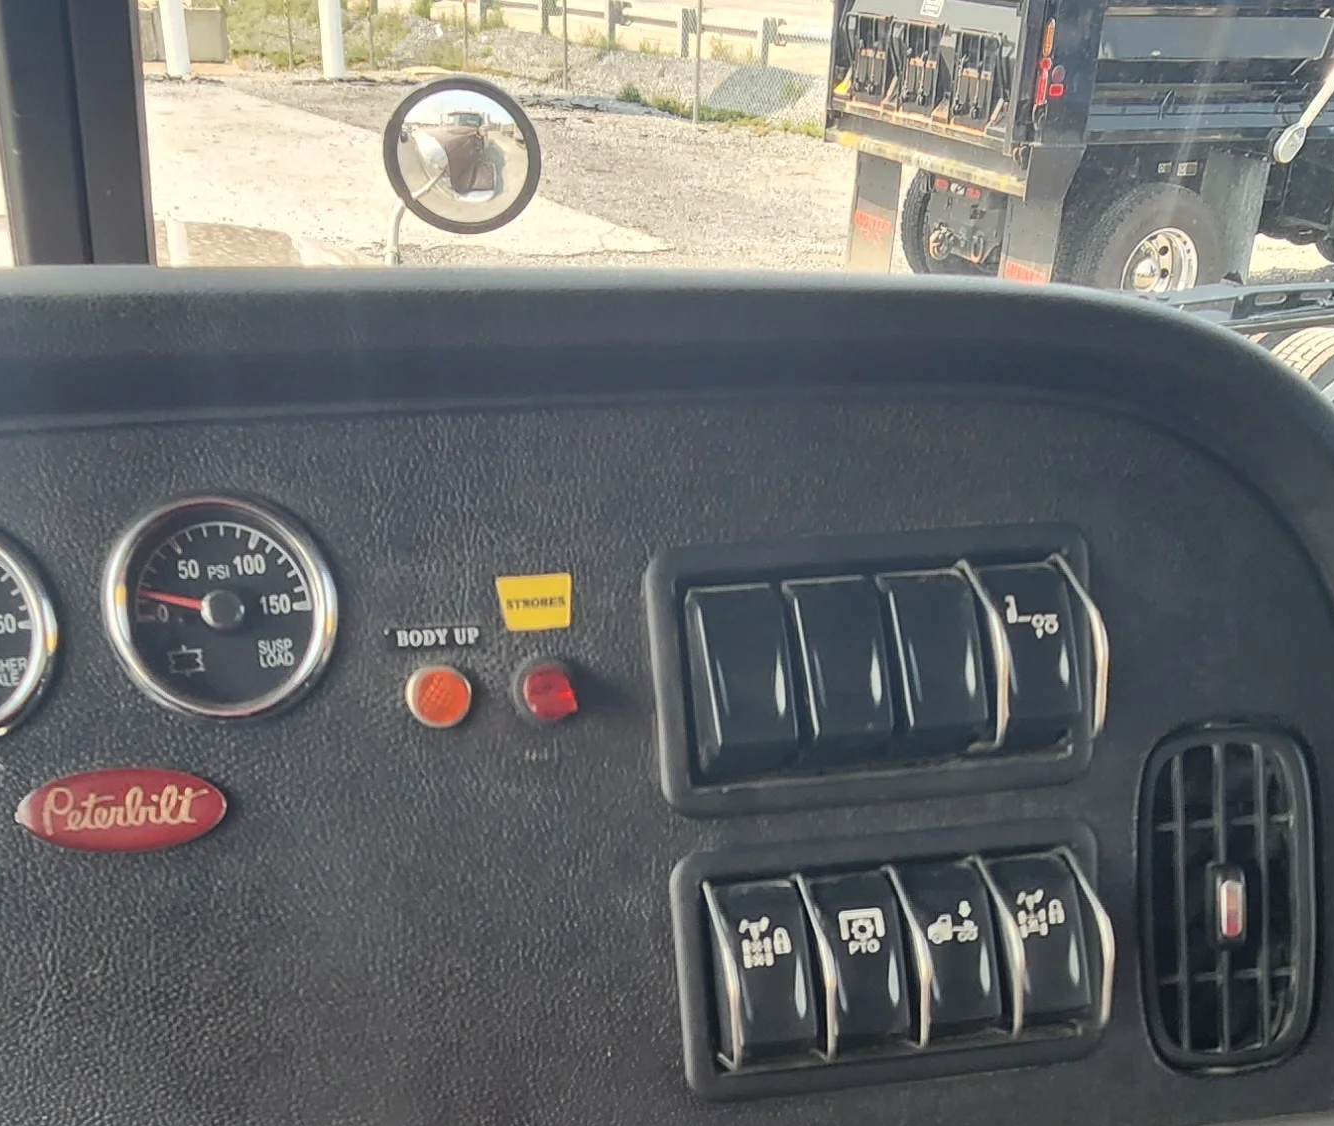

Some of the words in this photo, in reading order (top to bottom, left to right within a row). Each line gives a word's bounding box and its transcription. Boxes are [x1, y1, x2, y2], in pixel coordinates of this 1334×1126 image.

[178, 559, 200, 580] 50
[207, 565, 231, 580] PSI
[233, 556, 266, 576] 100
[260, 595, 291, 614] 150
[506, 596, 566, 609] STROBES
[258, 637, 293, 655] SUSP
[396, 629, 448, 647] BODY
[454, 627, 479, 645] UP
[259, 652, 295, 668] LOAD
[43, 786, 209, 836] Peterbilt
[849, 939, 881, 955] PTO
